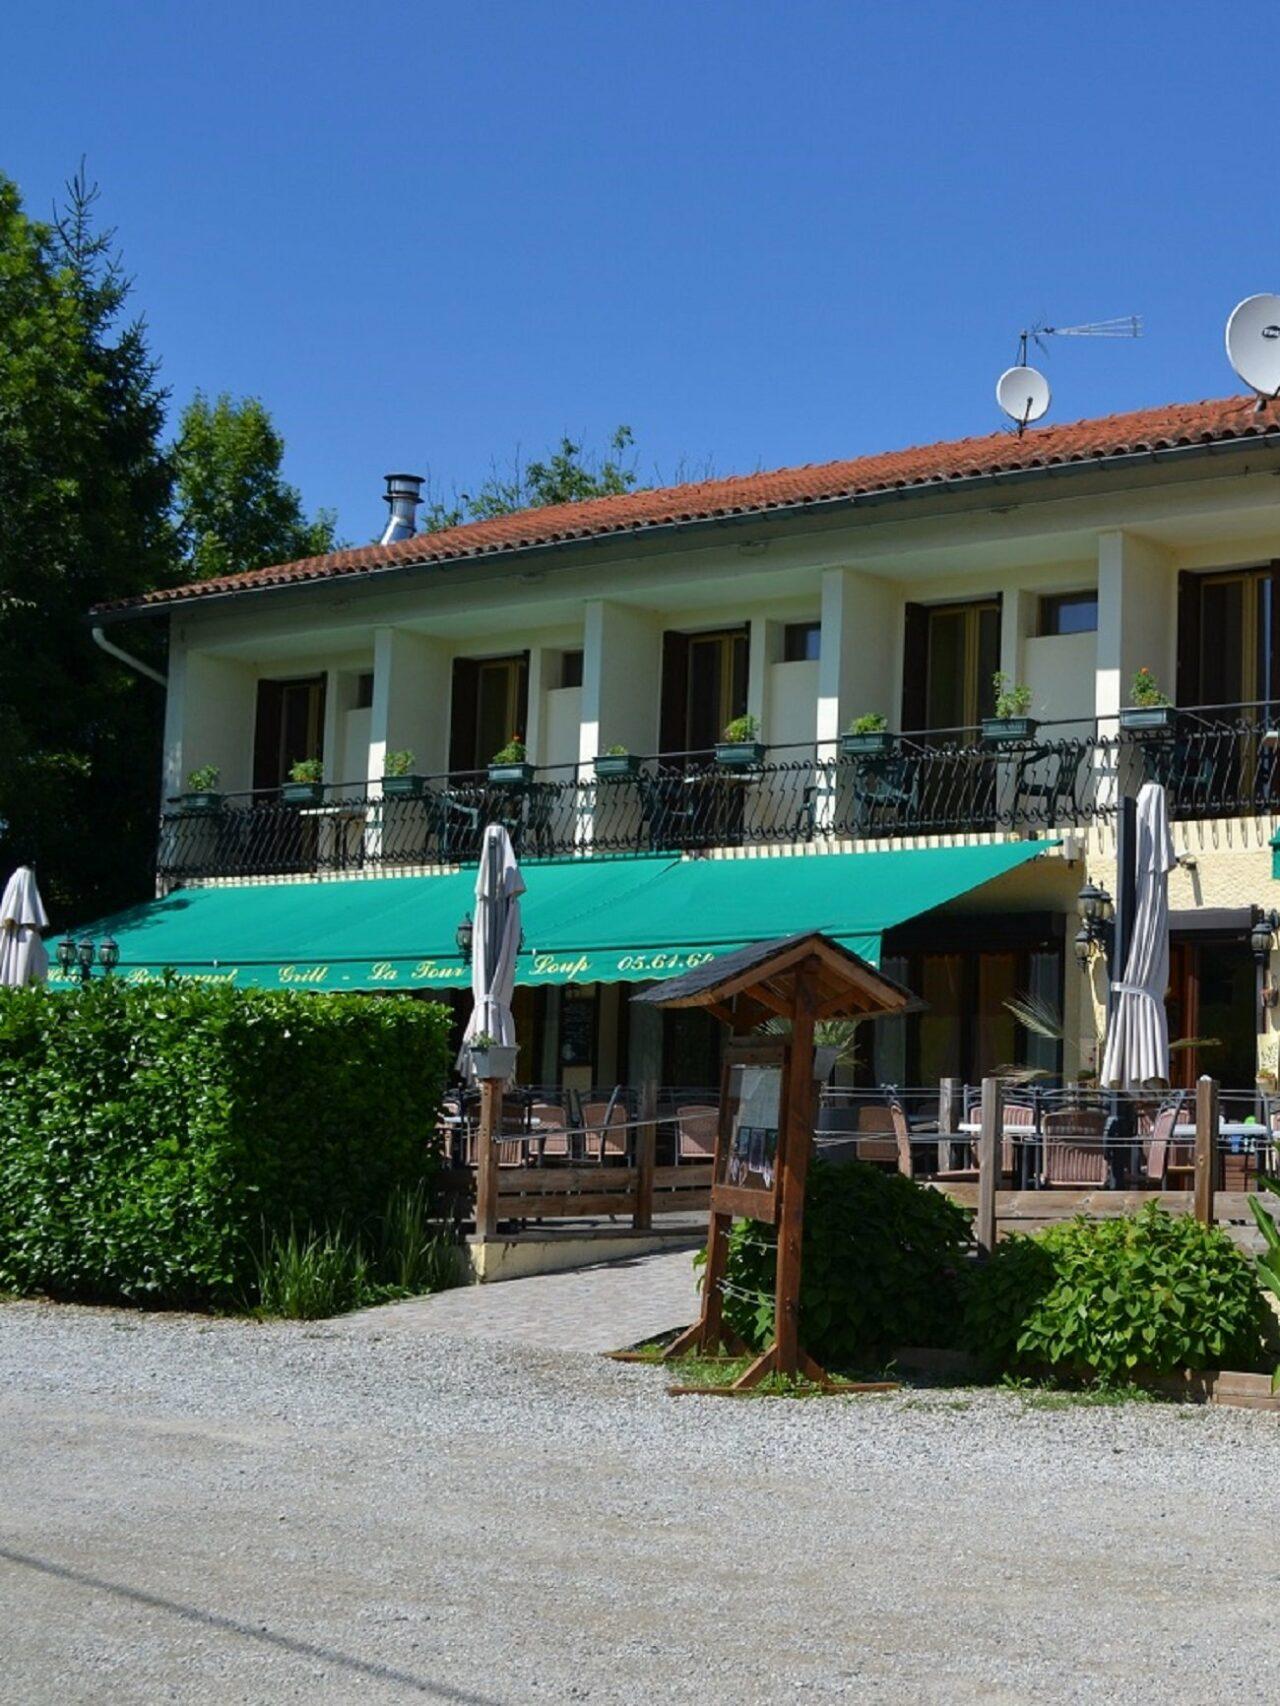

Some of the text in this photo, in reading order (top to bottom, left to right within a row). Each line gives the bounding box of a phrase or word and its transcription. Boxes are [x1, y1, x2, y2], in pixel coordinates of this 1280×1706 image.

[278, 965, 328, 983] Grill
[367, 961, 398, 980] La
[411, 961, 467, 979] Tour
[529, 954, 592, 979] Loup
